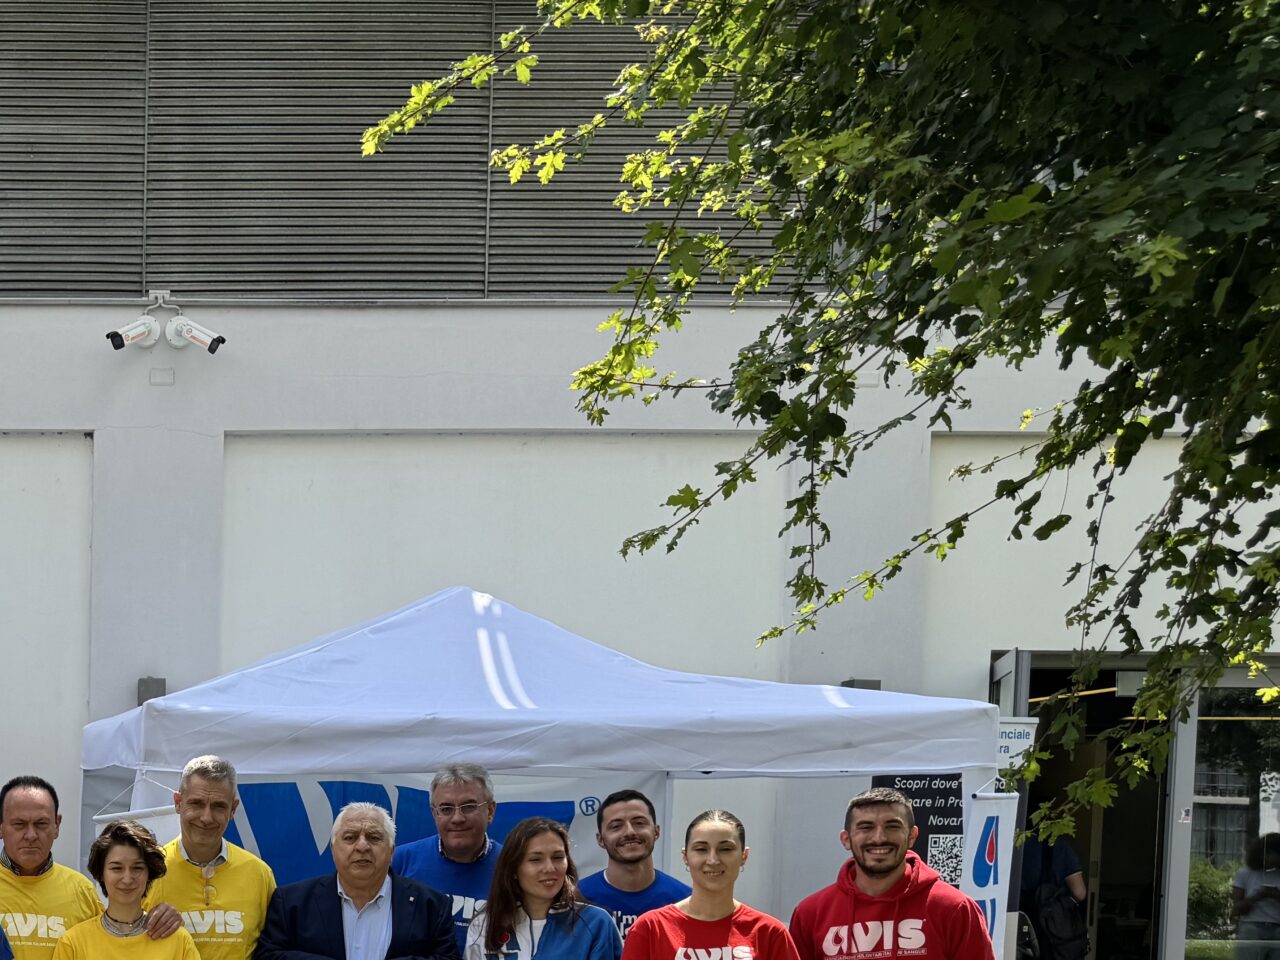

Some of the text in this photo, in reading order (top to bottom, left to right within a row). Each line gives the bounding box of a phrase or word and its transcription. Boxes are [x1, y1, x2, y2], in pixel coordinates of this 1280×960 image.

[999, 729, 1031, 740] nciale
[999, 745, 1010, 754] ra
[894, 777, 959, 793] Scopri dove
[935, 795, 946, 808] in
[928, 814, 964, 827] Novar
[822, 919, 926, 957] AVIS
